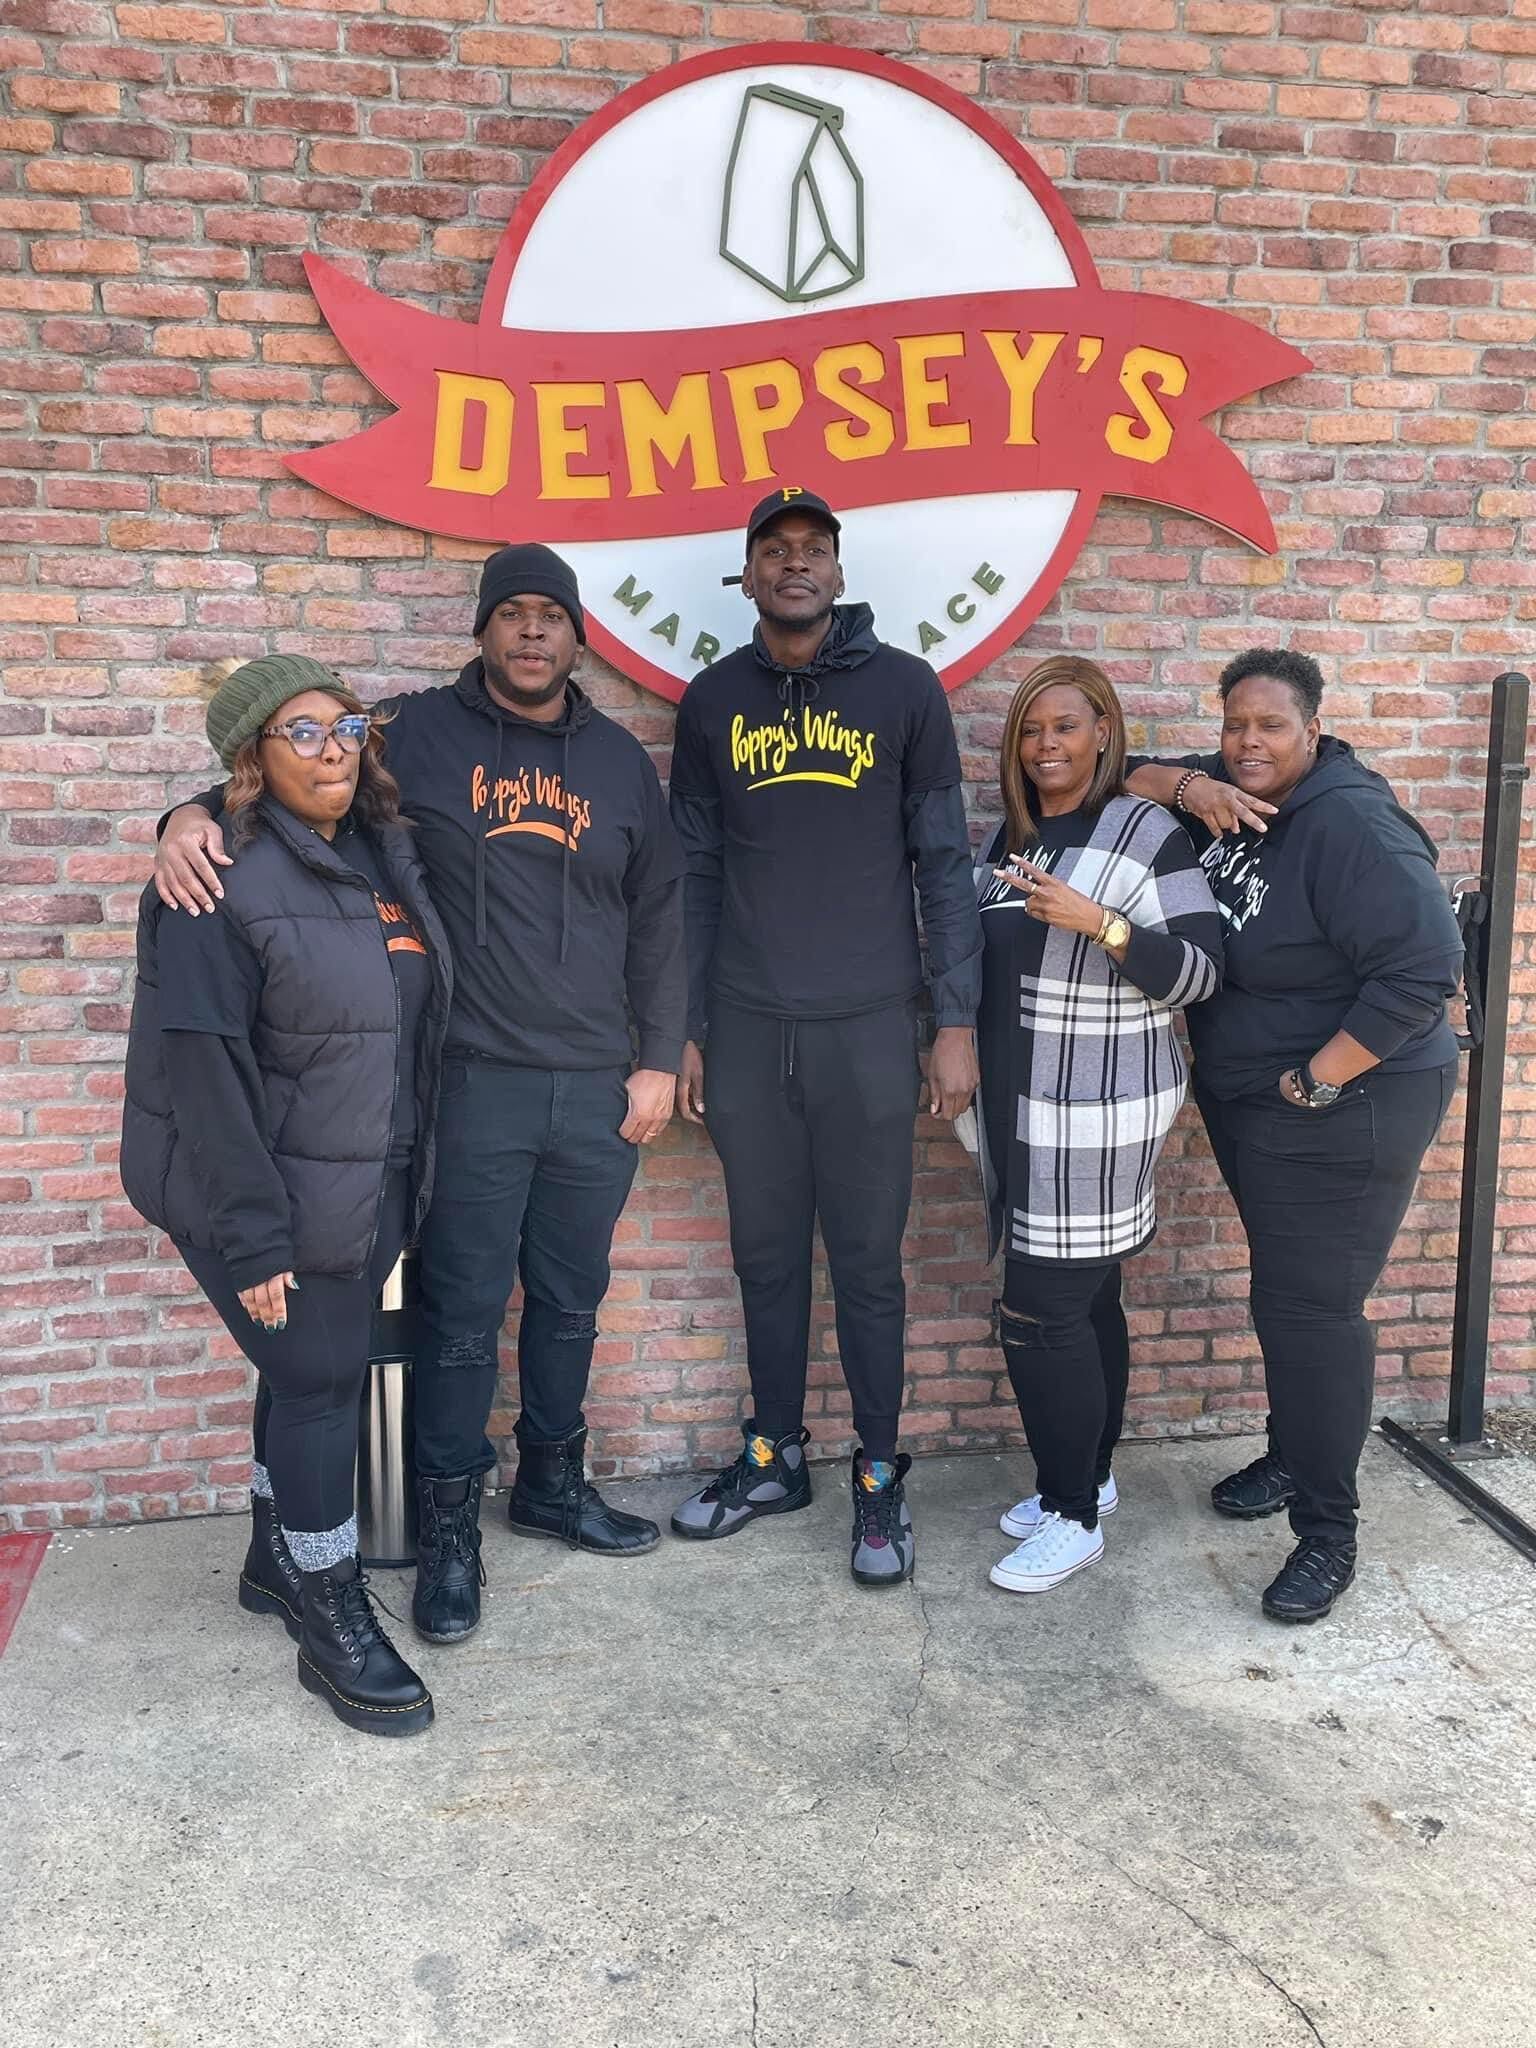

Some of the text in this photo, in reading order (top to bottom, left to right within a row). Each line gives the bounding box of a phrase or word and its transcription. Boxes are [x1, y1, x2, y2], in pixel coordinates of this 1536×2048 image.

[425, 330, 1190, 499] DEMPSEY'S
[782, 486, 803, 501] P
[613, 561, 1004, 666] MARACE
[731, 705, 875, 781] Poppy's Wings
[535, 767, 592, 838] Wings
